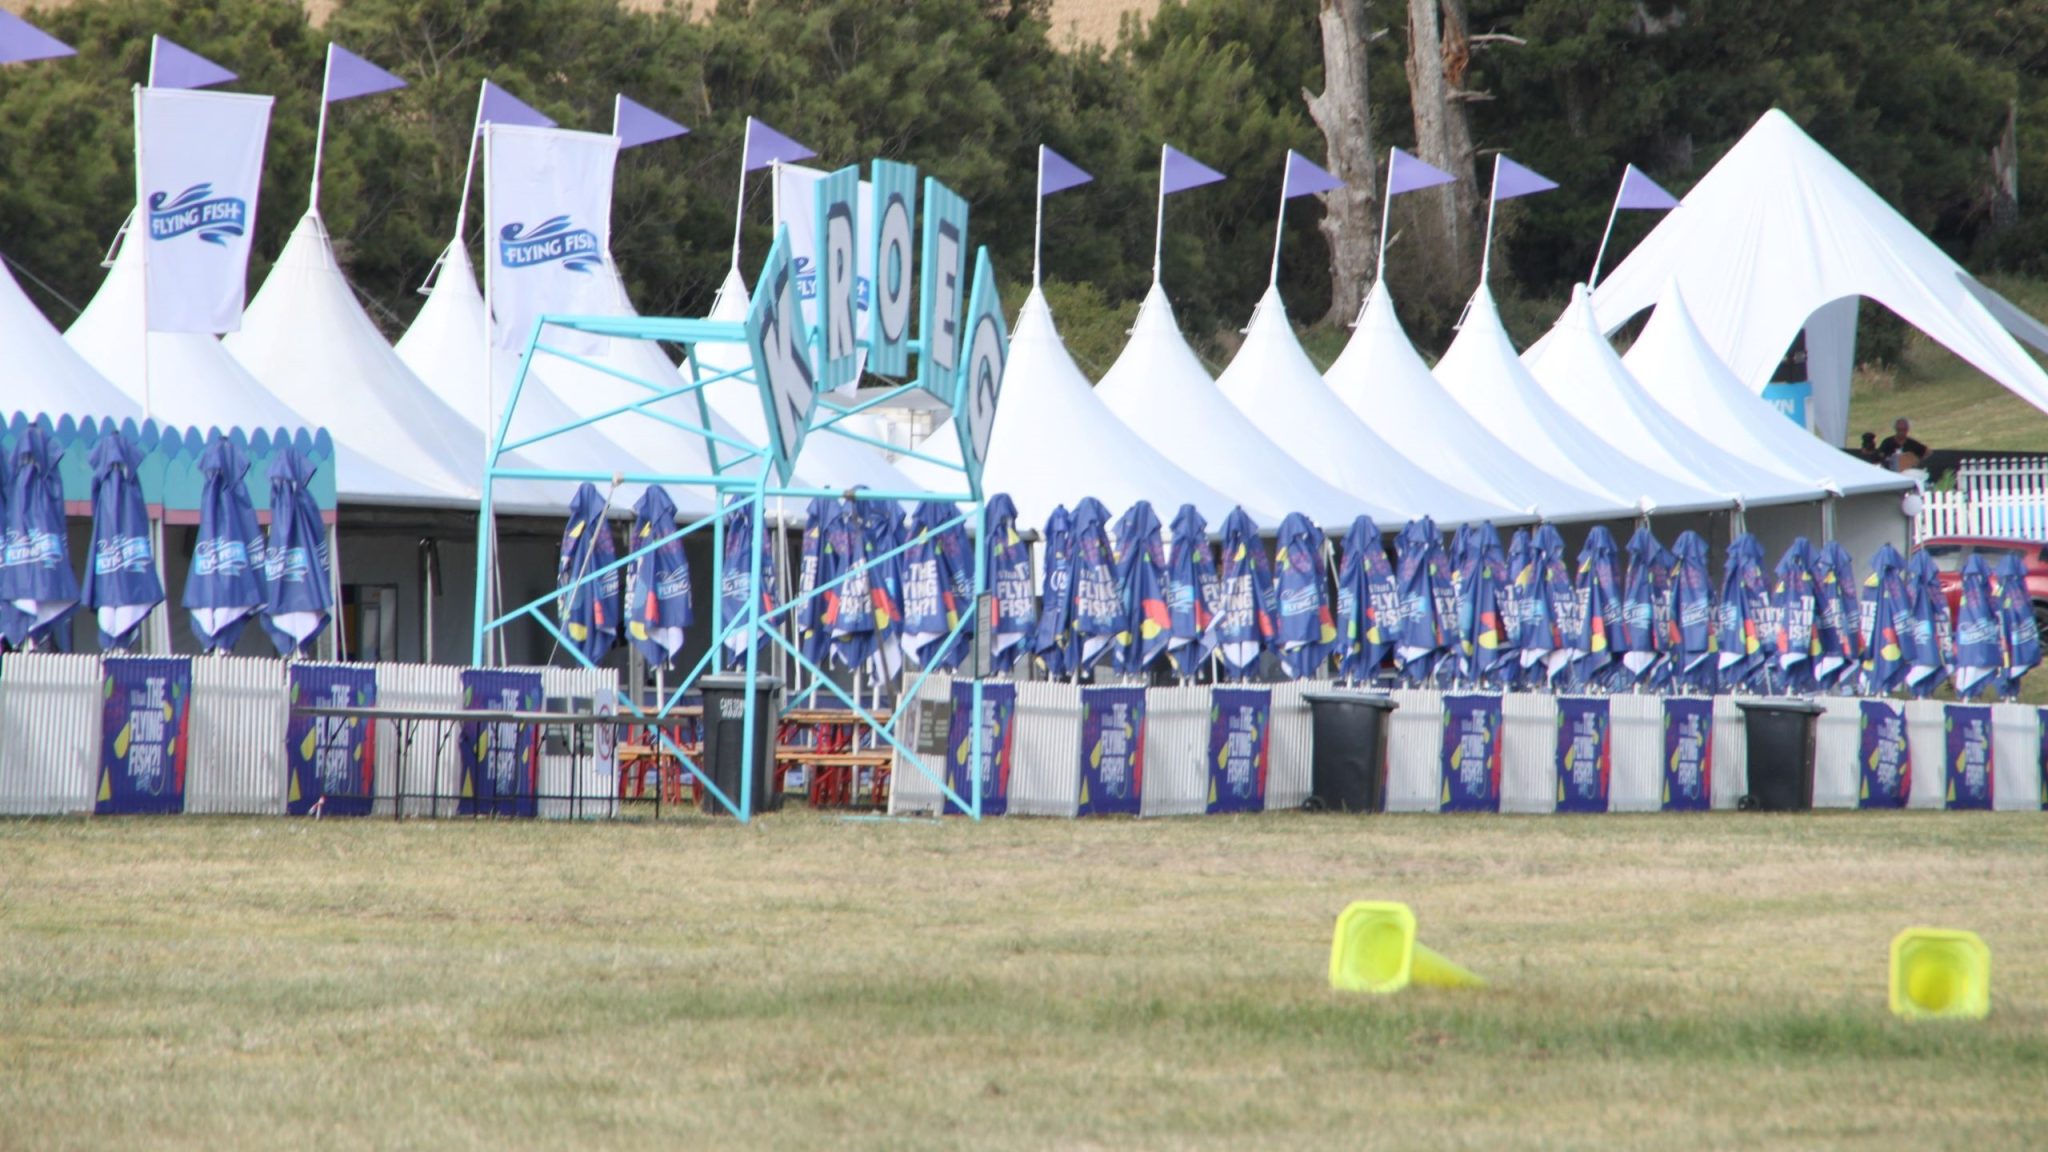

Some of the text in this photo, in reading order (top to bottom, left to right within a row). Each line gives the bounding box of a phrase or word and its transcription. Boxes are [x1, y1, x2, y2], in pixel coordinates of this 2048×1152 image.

[152, 202, 241, 236] FLYING FISH
[506, 239, 562, 264] FLYING
[760, 191, 1004, 465] KROEG
[909, 560, 937, 581] THE
[903, 579, 937, 600] YING
[904, 597, 937, 618] SH?!
[146, 677, 166, 709] THE
[331, 685, 351, 710] THE
[130, 710, 164, 742] FLYING
